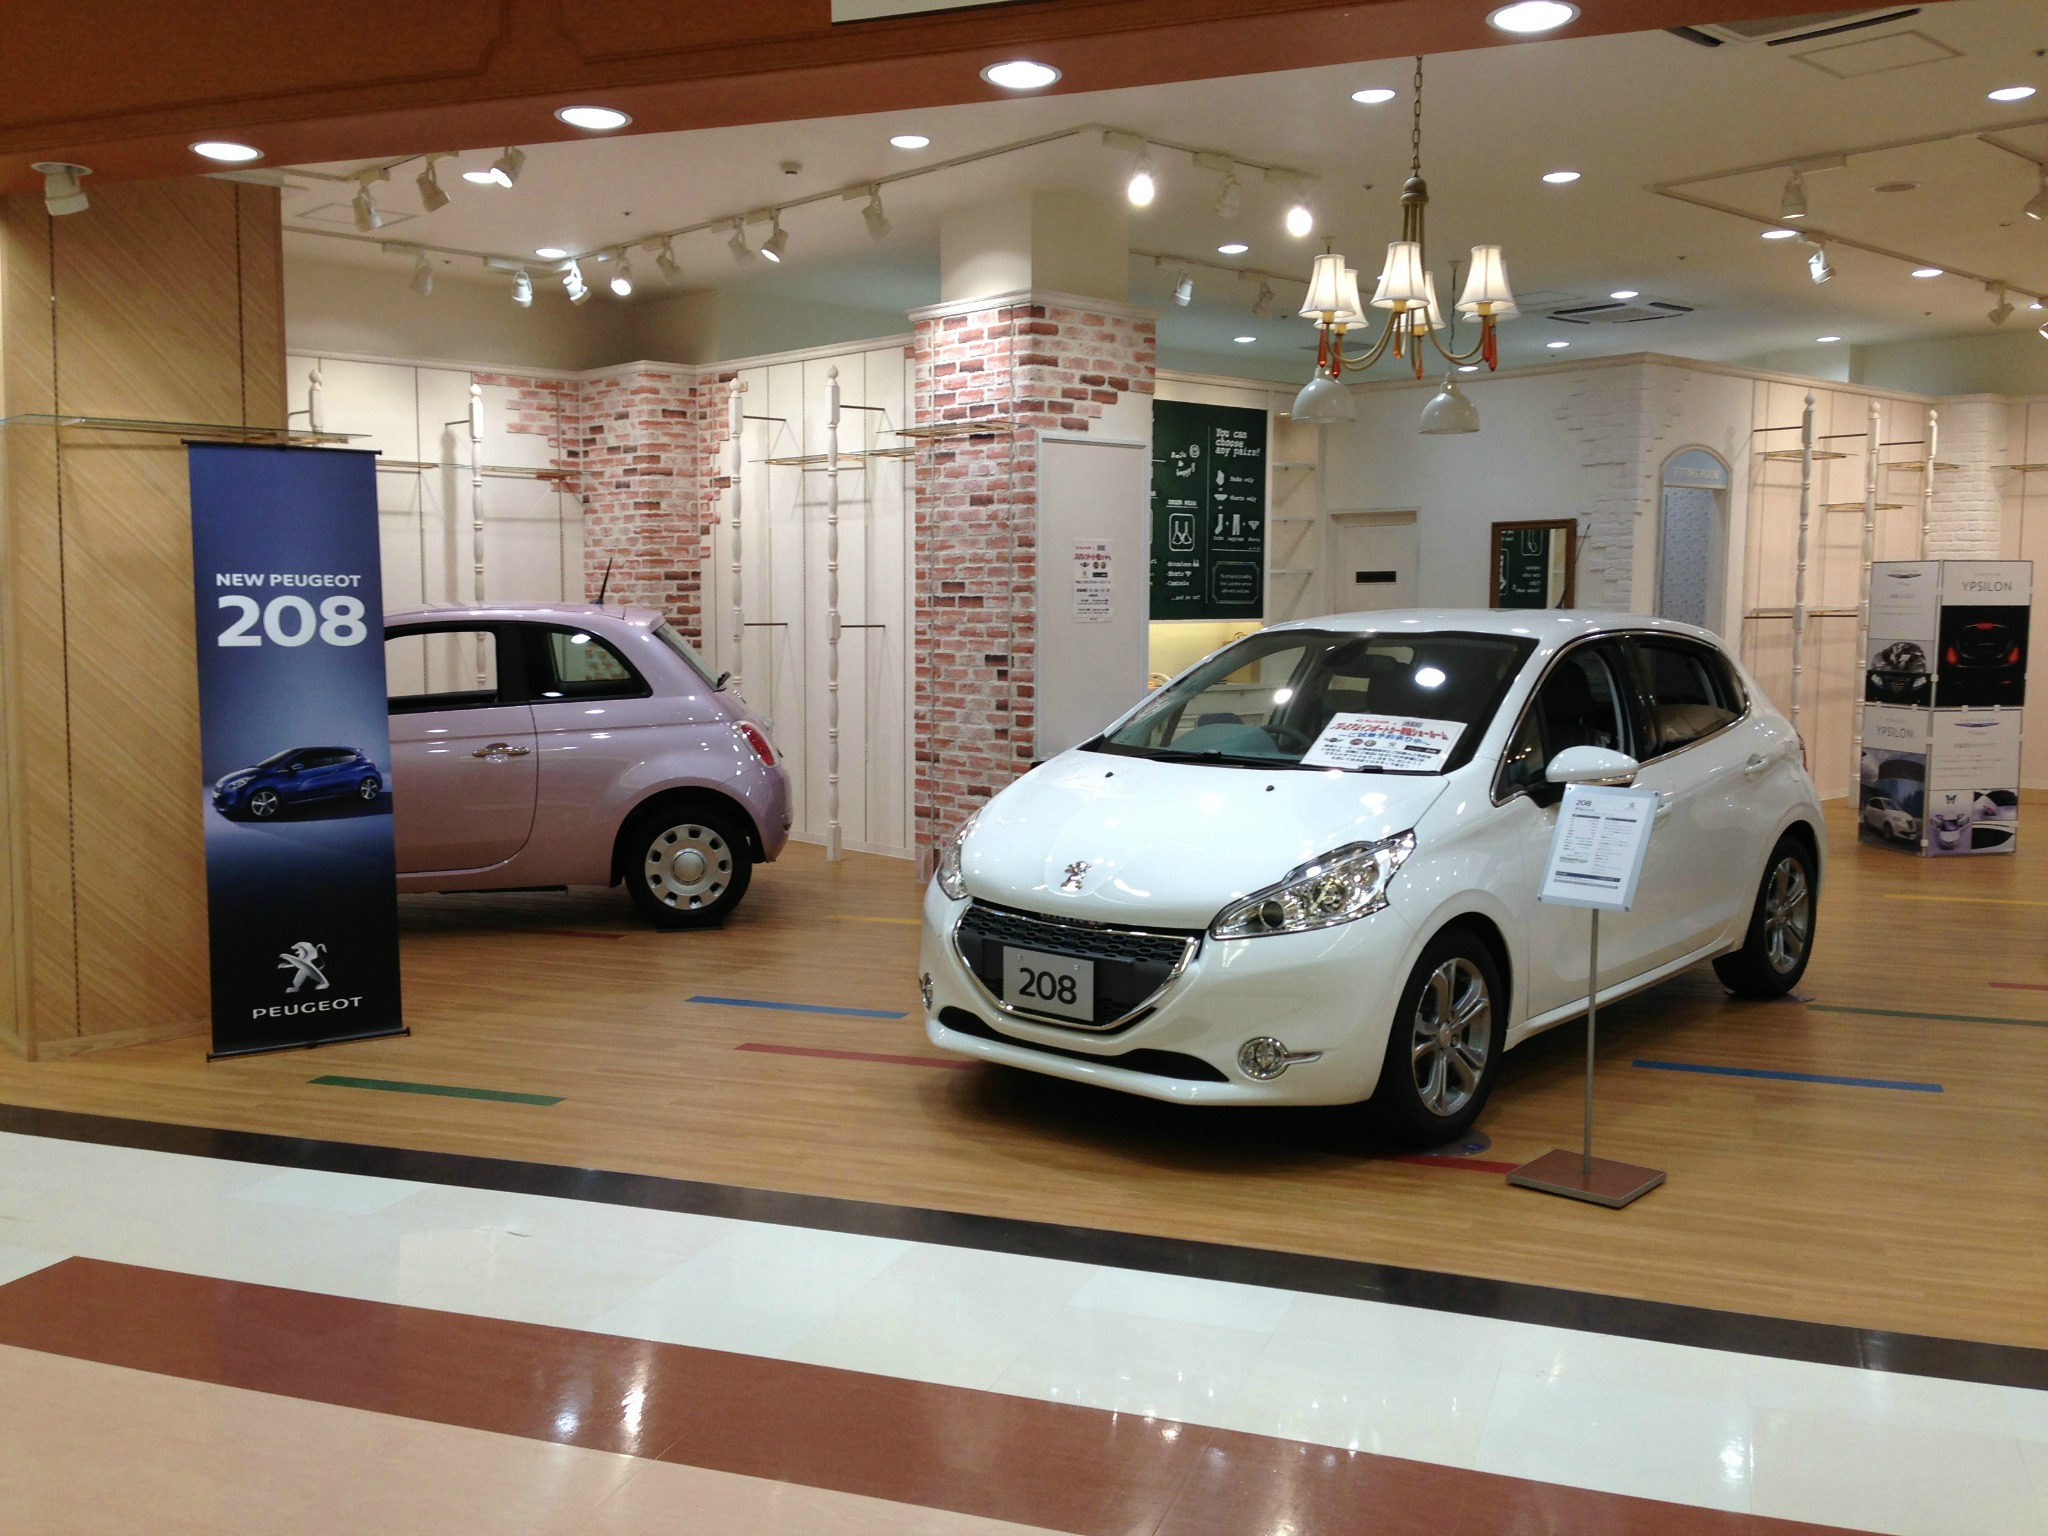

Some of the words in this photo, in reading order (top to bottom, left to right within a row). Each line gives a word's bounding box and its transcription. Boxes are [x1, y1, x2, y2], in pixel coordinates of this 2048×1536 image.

[1215, 428, 1229, 438] You
[1233, 431, 1247, 439] can
[1215, 437, 1244, 447] choose
[1215, 447, 1231, 457] any
[1233, 448, 1261, 458] pairs!
[215, 573, 265, 588] NEW
[268, 574, 361, 588] PEUGEOT
[1962, 581, 2012, 592] YPSILON
[217, 595, 368, 647] 208
[1876, 726, 1914, 739] YPSILON
[1576, 799, 1592, 807] 208
[1018, 967, 1078, 1005] 208
[252, 995, 363, 1019] PEUGEOT
